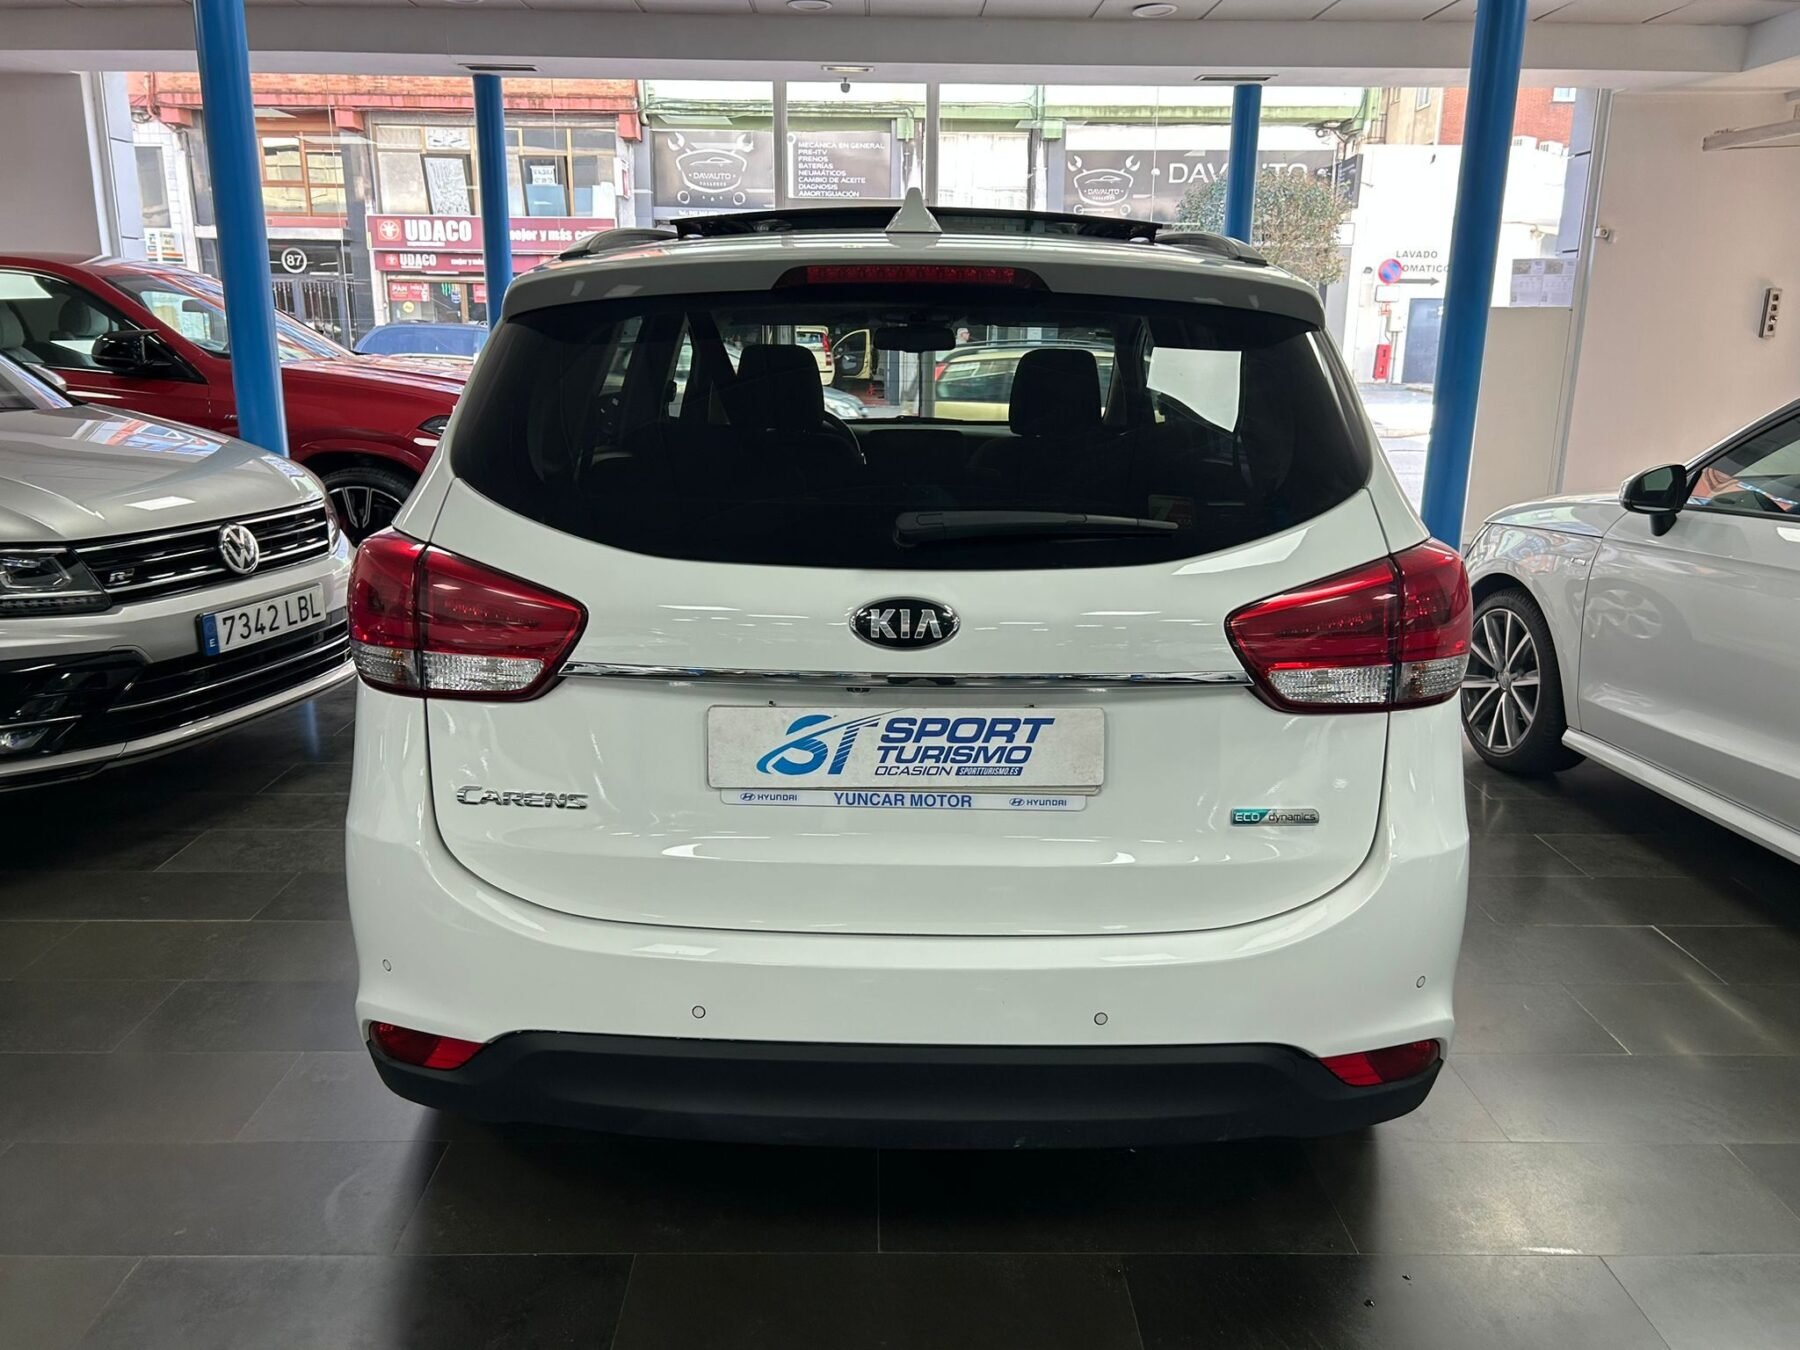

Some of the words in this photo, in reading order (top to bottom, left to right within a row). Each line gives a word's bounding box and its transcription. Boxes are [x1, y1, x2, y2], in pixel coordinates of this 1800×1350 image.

[850, 142, 886, 150] GENERAL
[693, 172, 732, 180] DAVAUTO
[1168, 162, 1308, 184] DAVTO
[404, 219, 472, 242] UDACO
[286, 254, 302, 266] 87
[399, 253, 437, 266] UDACO
[1395, 250, 1438, 259] LAVADO
[1401, 264, 1449, 272] OMATICO
[222, 604, 280, 645] 7342
[285, 593, 321, 626] LBL
[869, 608, 943, 638] KIA
[209, 638, 216, 648] E
[880, 717, 1056, 744] SPORT
[876, 745, 1033, 764] TURISMO
[875, 766, 953, 776] OCASION
[958, 766, 1020, 776] SPORTTURISMO.ES
[456, 785, 589, 810] CARENS
[834, 792, 905, 806] YUNCAR
[910, 794, 972, 807] MOTOR
[1026, 799, 1067, 807] HYUNDAI
[1235, 812, 1260, 822] ECO
[1268, 812, 1316, 823] dynamics
